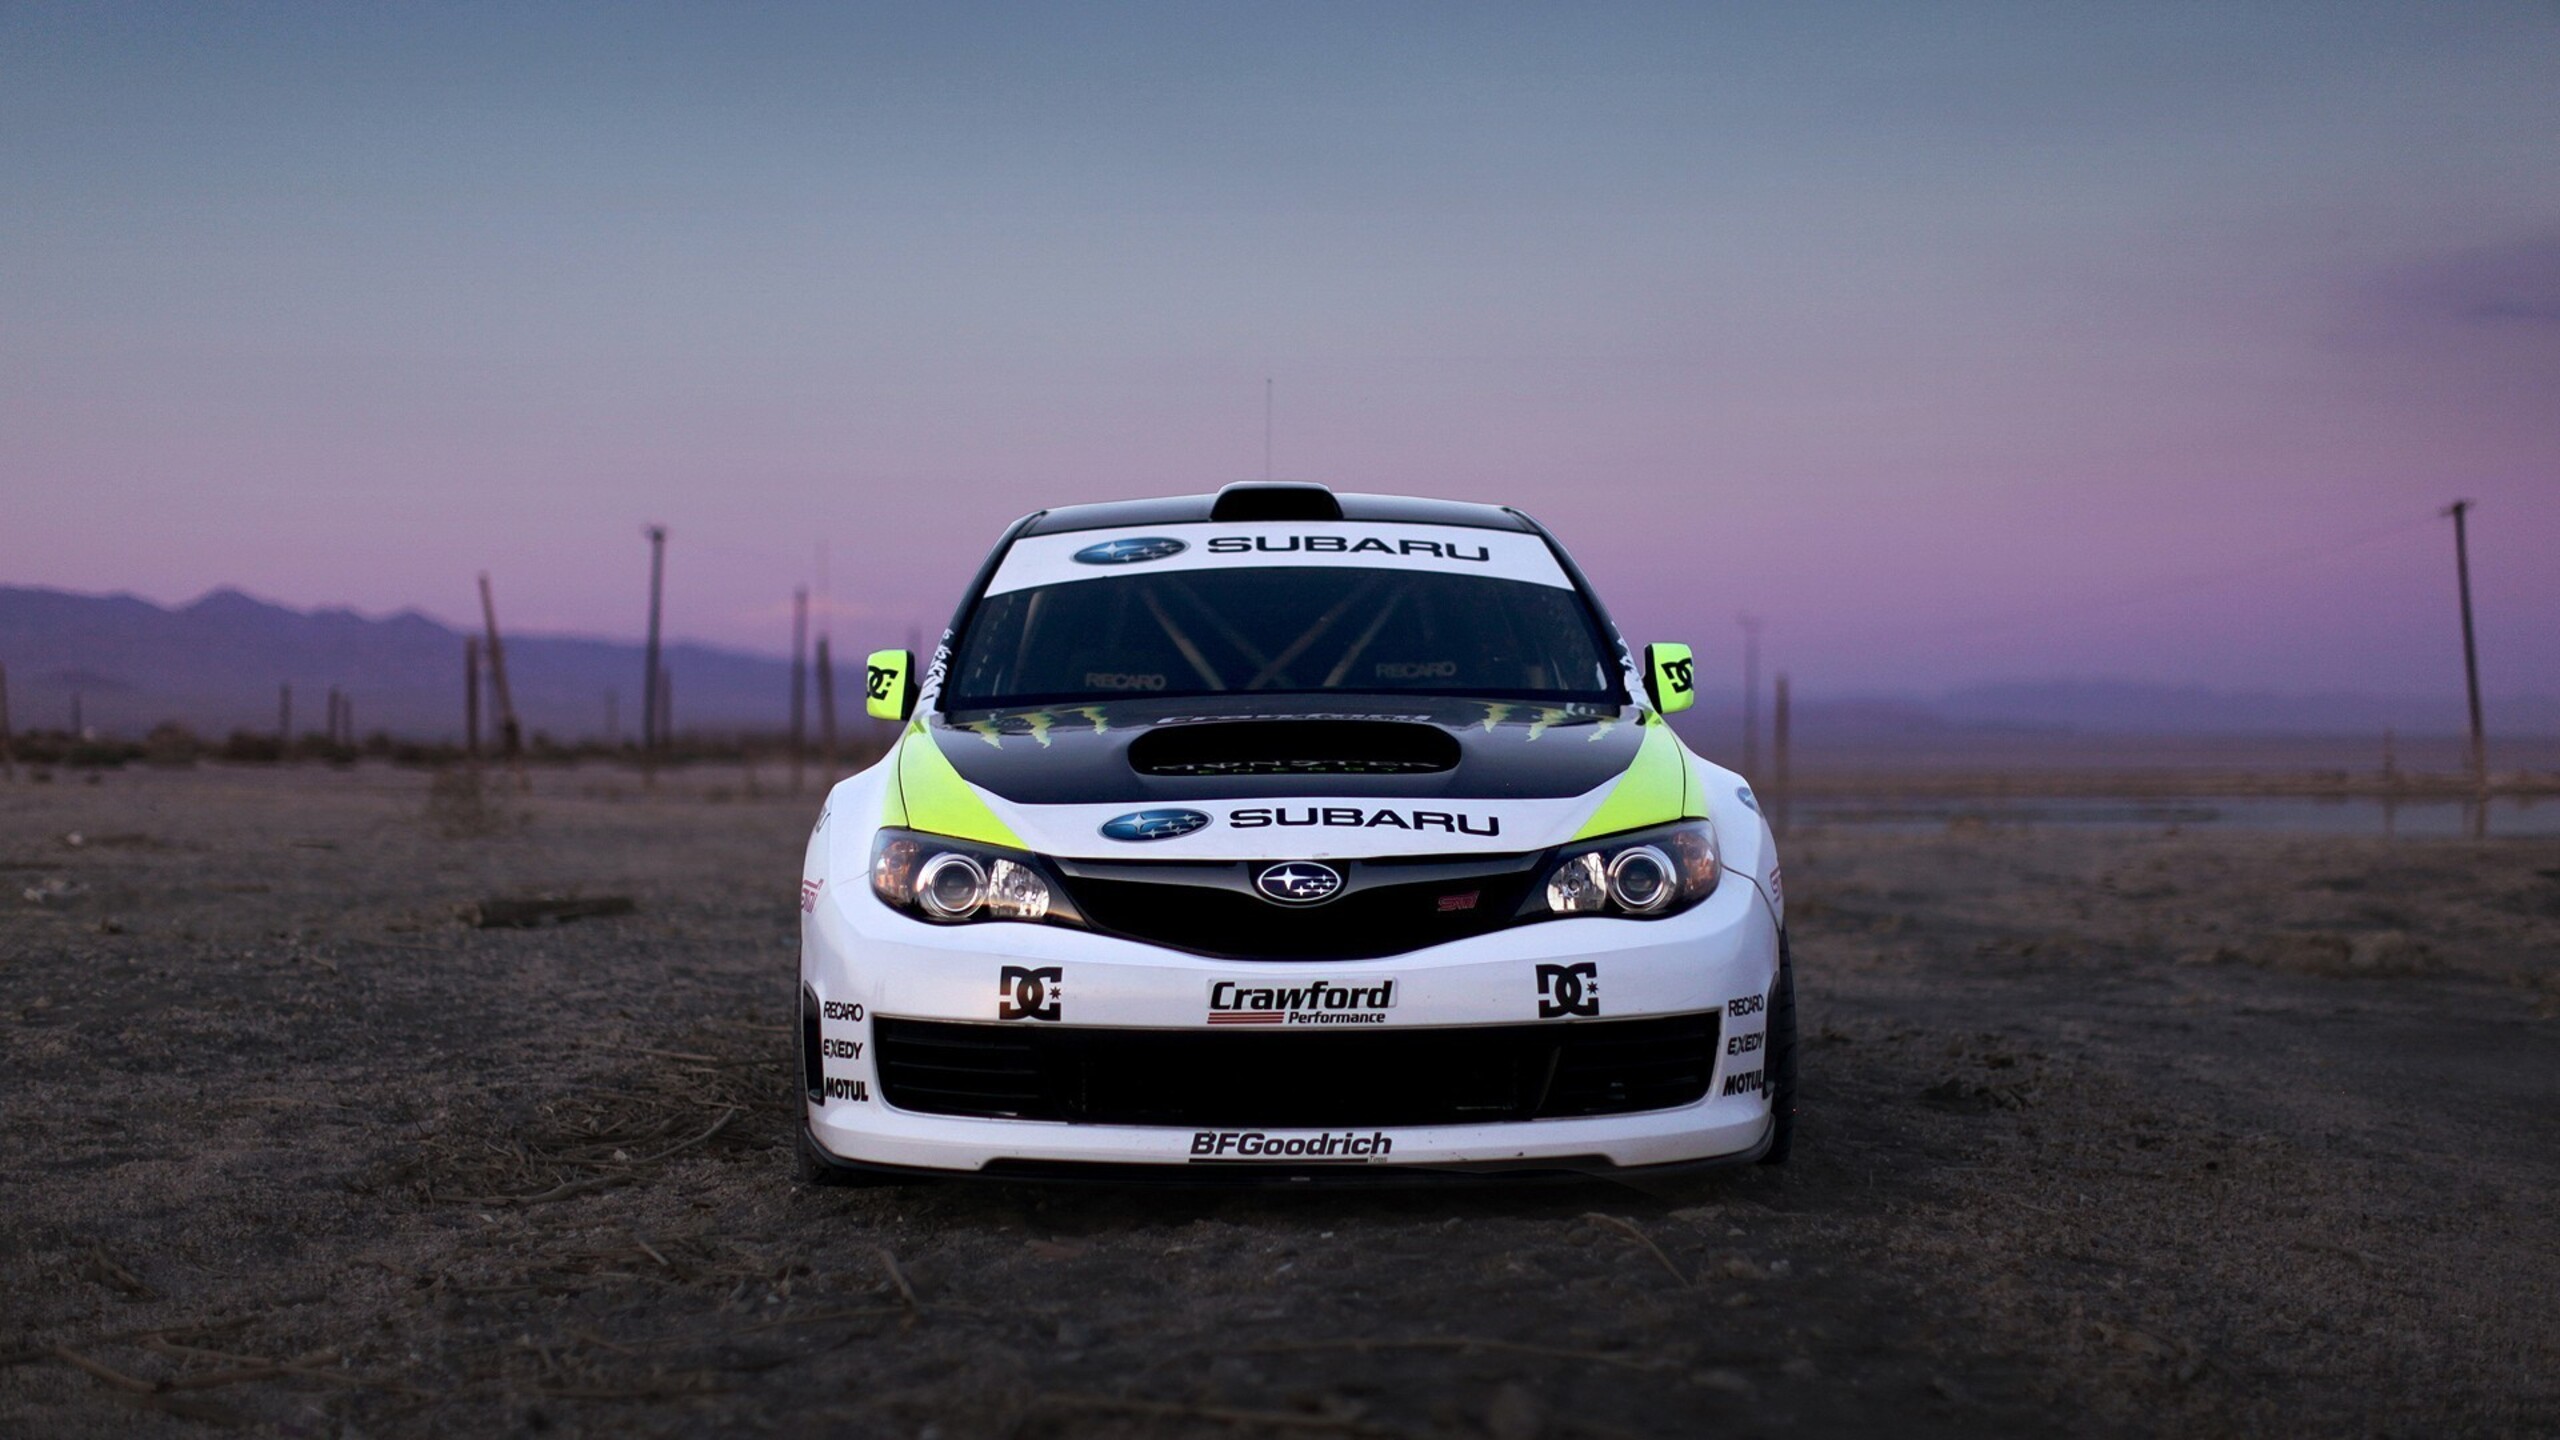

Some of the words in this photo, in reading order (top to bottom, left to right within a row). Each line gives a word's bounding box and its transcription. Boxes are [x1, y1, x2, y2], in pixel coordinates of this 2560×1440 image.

[1207, 535, 1490, 562] SUBARU
[1085, 672, 1166, 691] RECARO
[1376, 661, 1456, 679] RECARO
[1229, 807, 1499, 837] SUBARU
[999, 965, 1063, 1022] DC
[1210, 980, 1394, 1010] Crawford
[1535, 962, 1600, 1019] DC
[823, 1001, 864, 1022] RECARO
[1288, 1011, 1386, 1024] Performance
[1728, 993, 1764, 1017] RECARO
[823, 1039, 863, 1060] EXEDY
[1727, 1031, 1765, 1056] EXEDY
[825, 1077, 869, 1102] MOTUL
[1722, 1069, 1765, 1097] MOTUL
[1190, 1132, 1392, 1155] BFGoodrich
